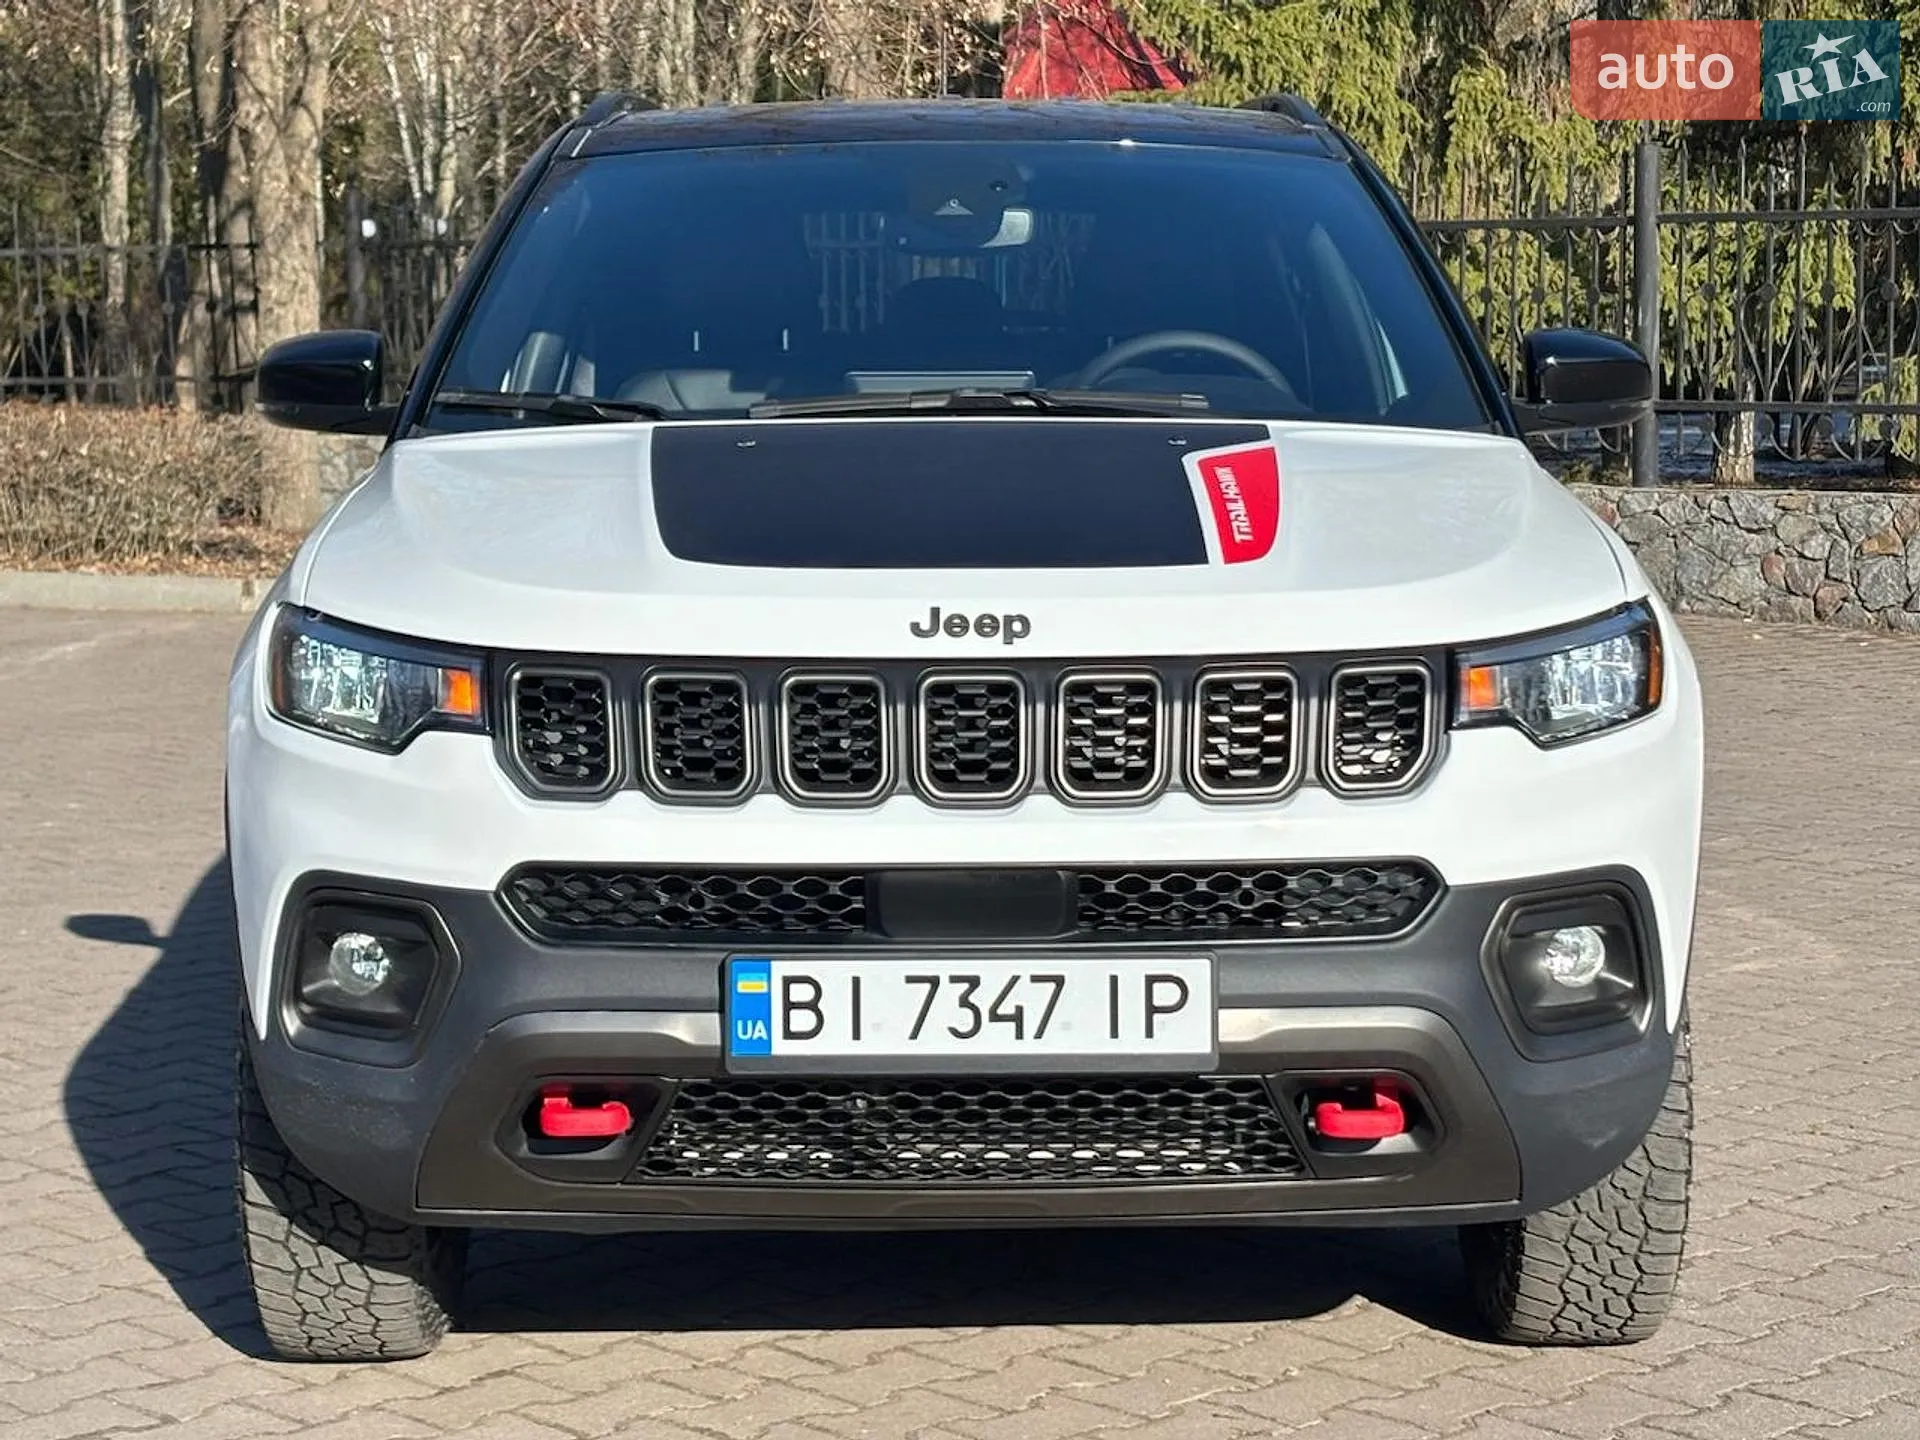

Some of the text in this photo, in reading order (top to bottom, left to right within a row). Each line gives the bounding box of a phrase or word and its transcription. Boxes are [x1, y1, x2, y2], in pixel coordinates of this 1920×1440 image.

[910, 606, 1031, 645] Jeep
[781, 974, 1190, 1041] BI 7347 IP
[737, 1020, 768, 1041] UA
